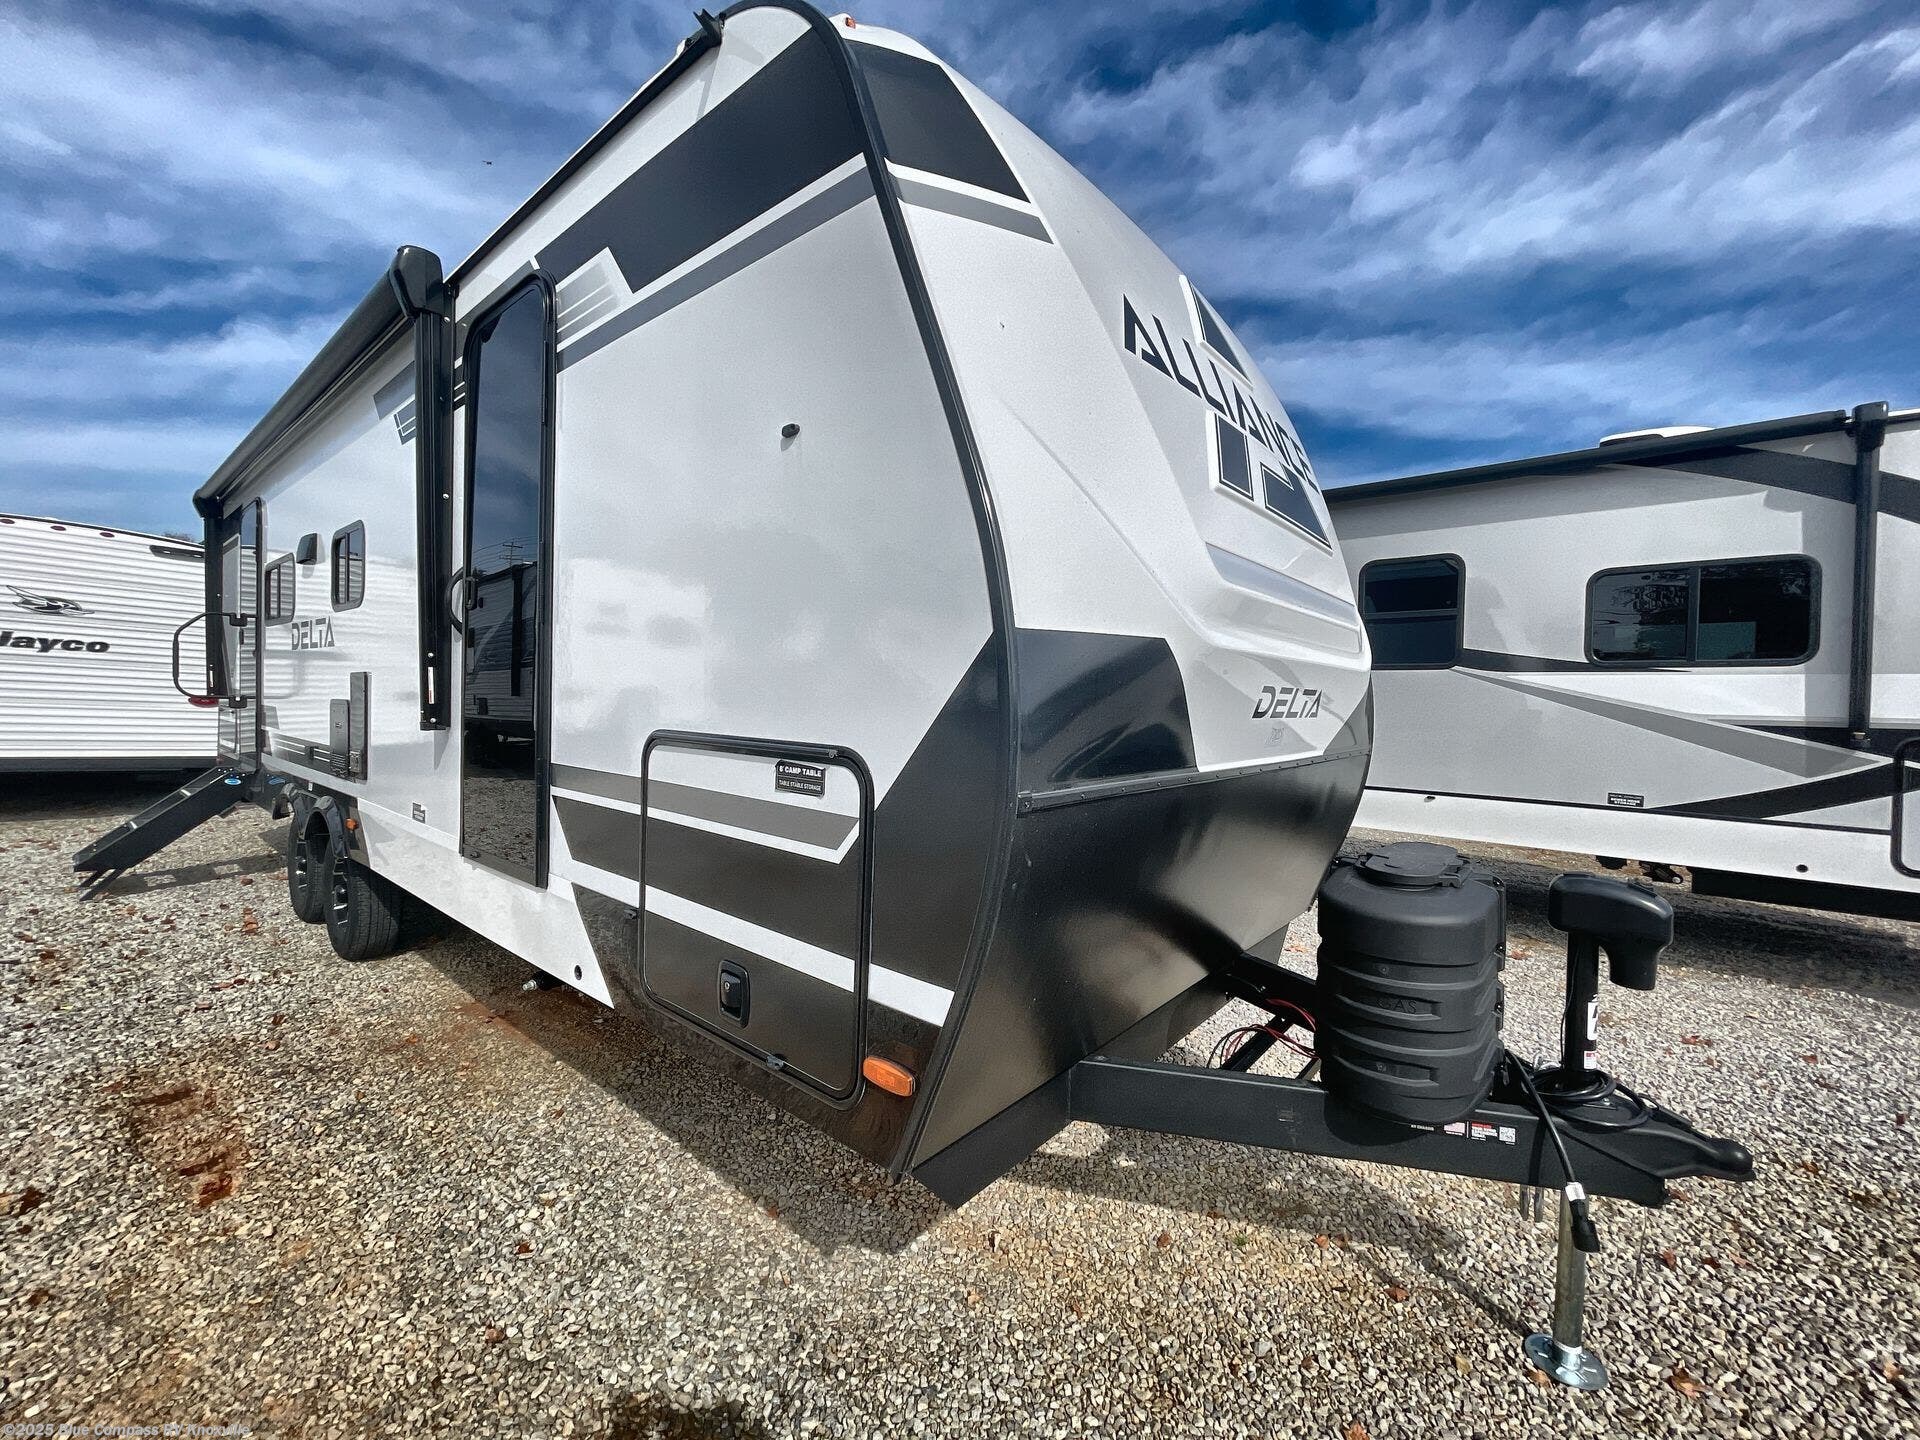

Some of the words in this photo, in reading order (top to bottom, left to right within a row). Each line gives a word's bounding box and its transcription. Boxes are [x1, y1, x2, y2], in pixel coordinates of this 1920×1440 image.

[1122, 292, 1320, 494] ALLIANCE
[0, 631, 110, 653] Jayco
[291, 616, 335, 650] DELTA
[1251, 685, 1322, 719] DELTA
[784, 766, 801, 775] CAMP
[802, 768, 822, 777] TABLE
